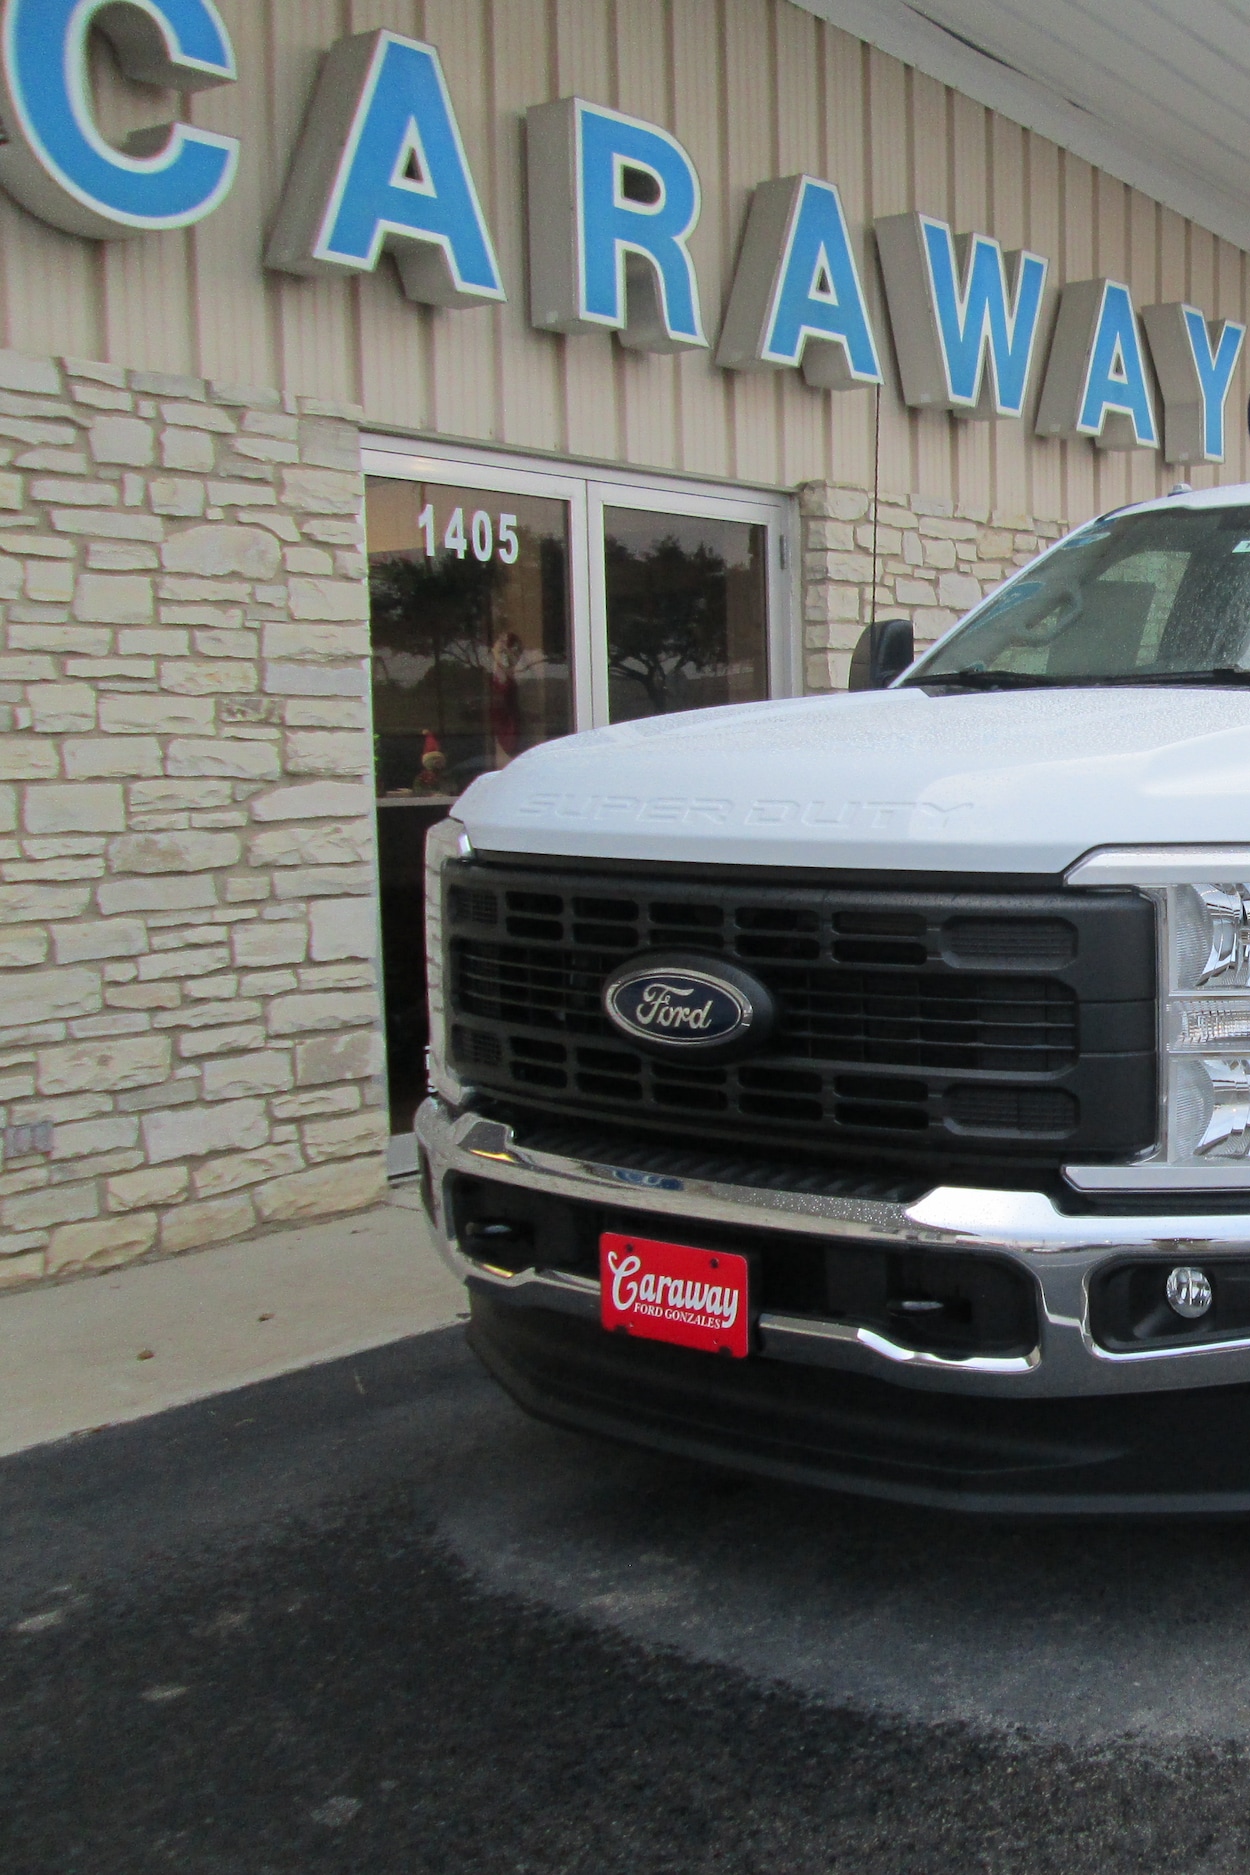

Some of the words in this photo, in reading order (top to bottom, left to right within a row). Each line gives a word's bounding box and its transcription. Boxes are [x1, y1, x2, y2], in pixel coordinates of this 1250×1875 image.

[2, 0, 1247, 465] CARAWAY
[418, 503, 519, 565] 1405
[518, 791, 736, 826] SUPER
[742, 799, 976, 829] DUTY
[635, 983, 713, 1030] Ford
[607, 1250, 739, 1329] Caraway
[633, 1301, 664, 1318] FORD
[664, 1308, 723, 1330] GONZALES
